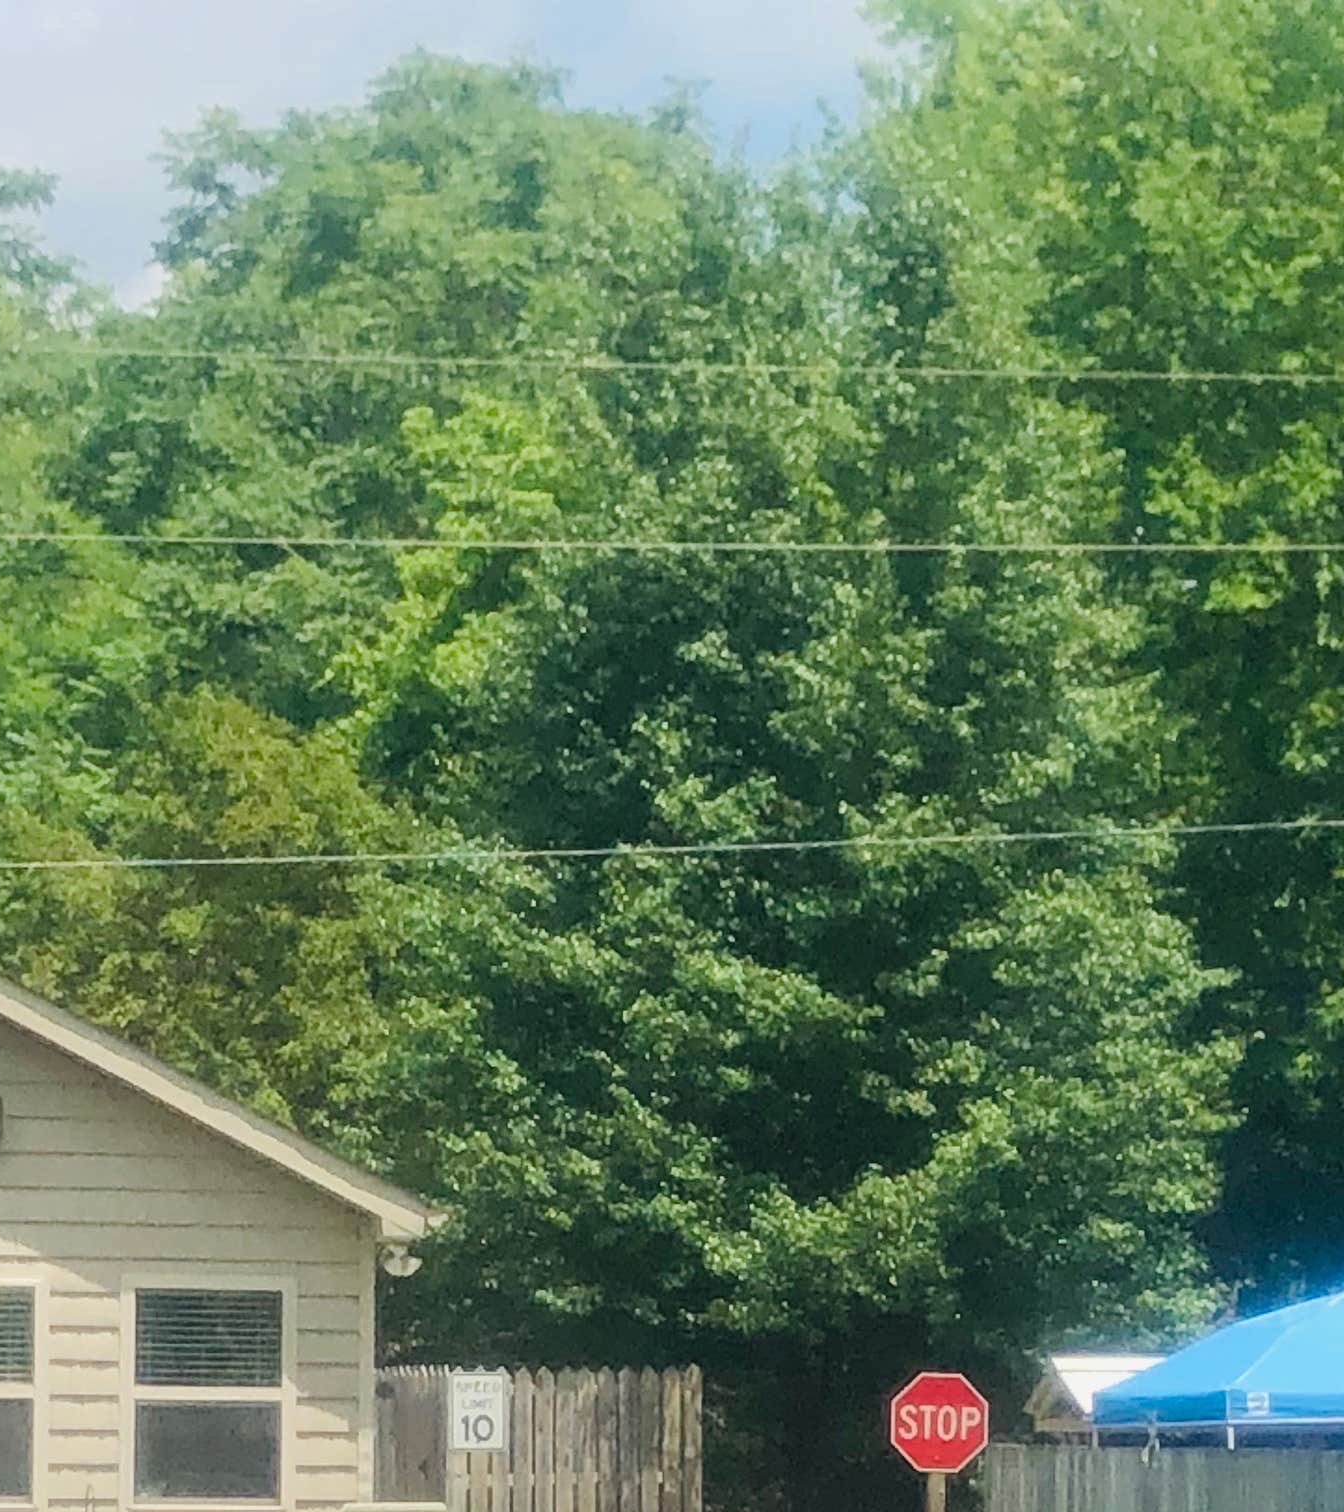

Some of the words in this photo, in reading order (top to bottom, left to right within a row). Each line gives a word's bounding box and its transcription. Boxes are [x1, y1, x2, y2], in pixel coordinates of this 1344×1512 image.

[456, 1381, 501, 1393] SPEED
[461, 1398, 494, 1409] LIMIT
[461, 1414, 494, 1442] 10
[898, 1404, 981, 1441] STOP
